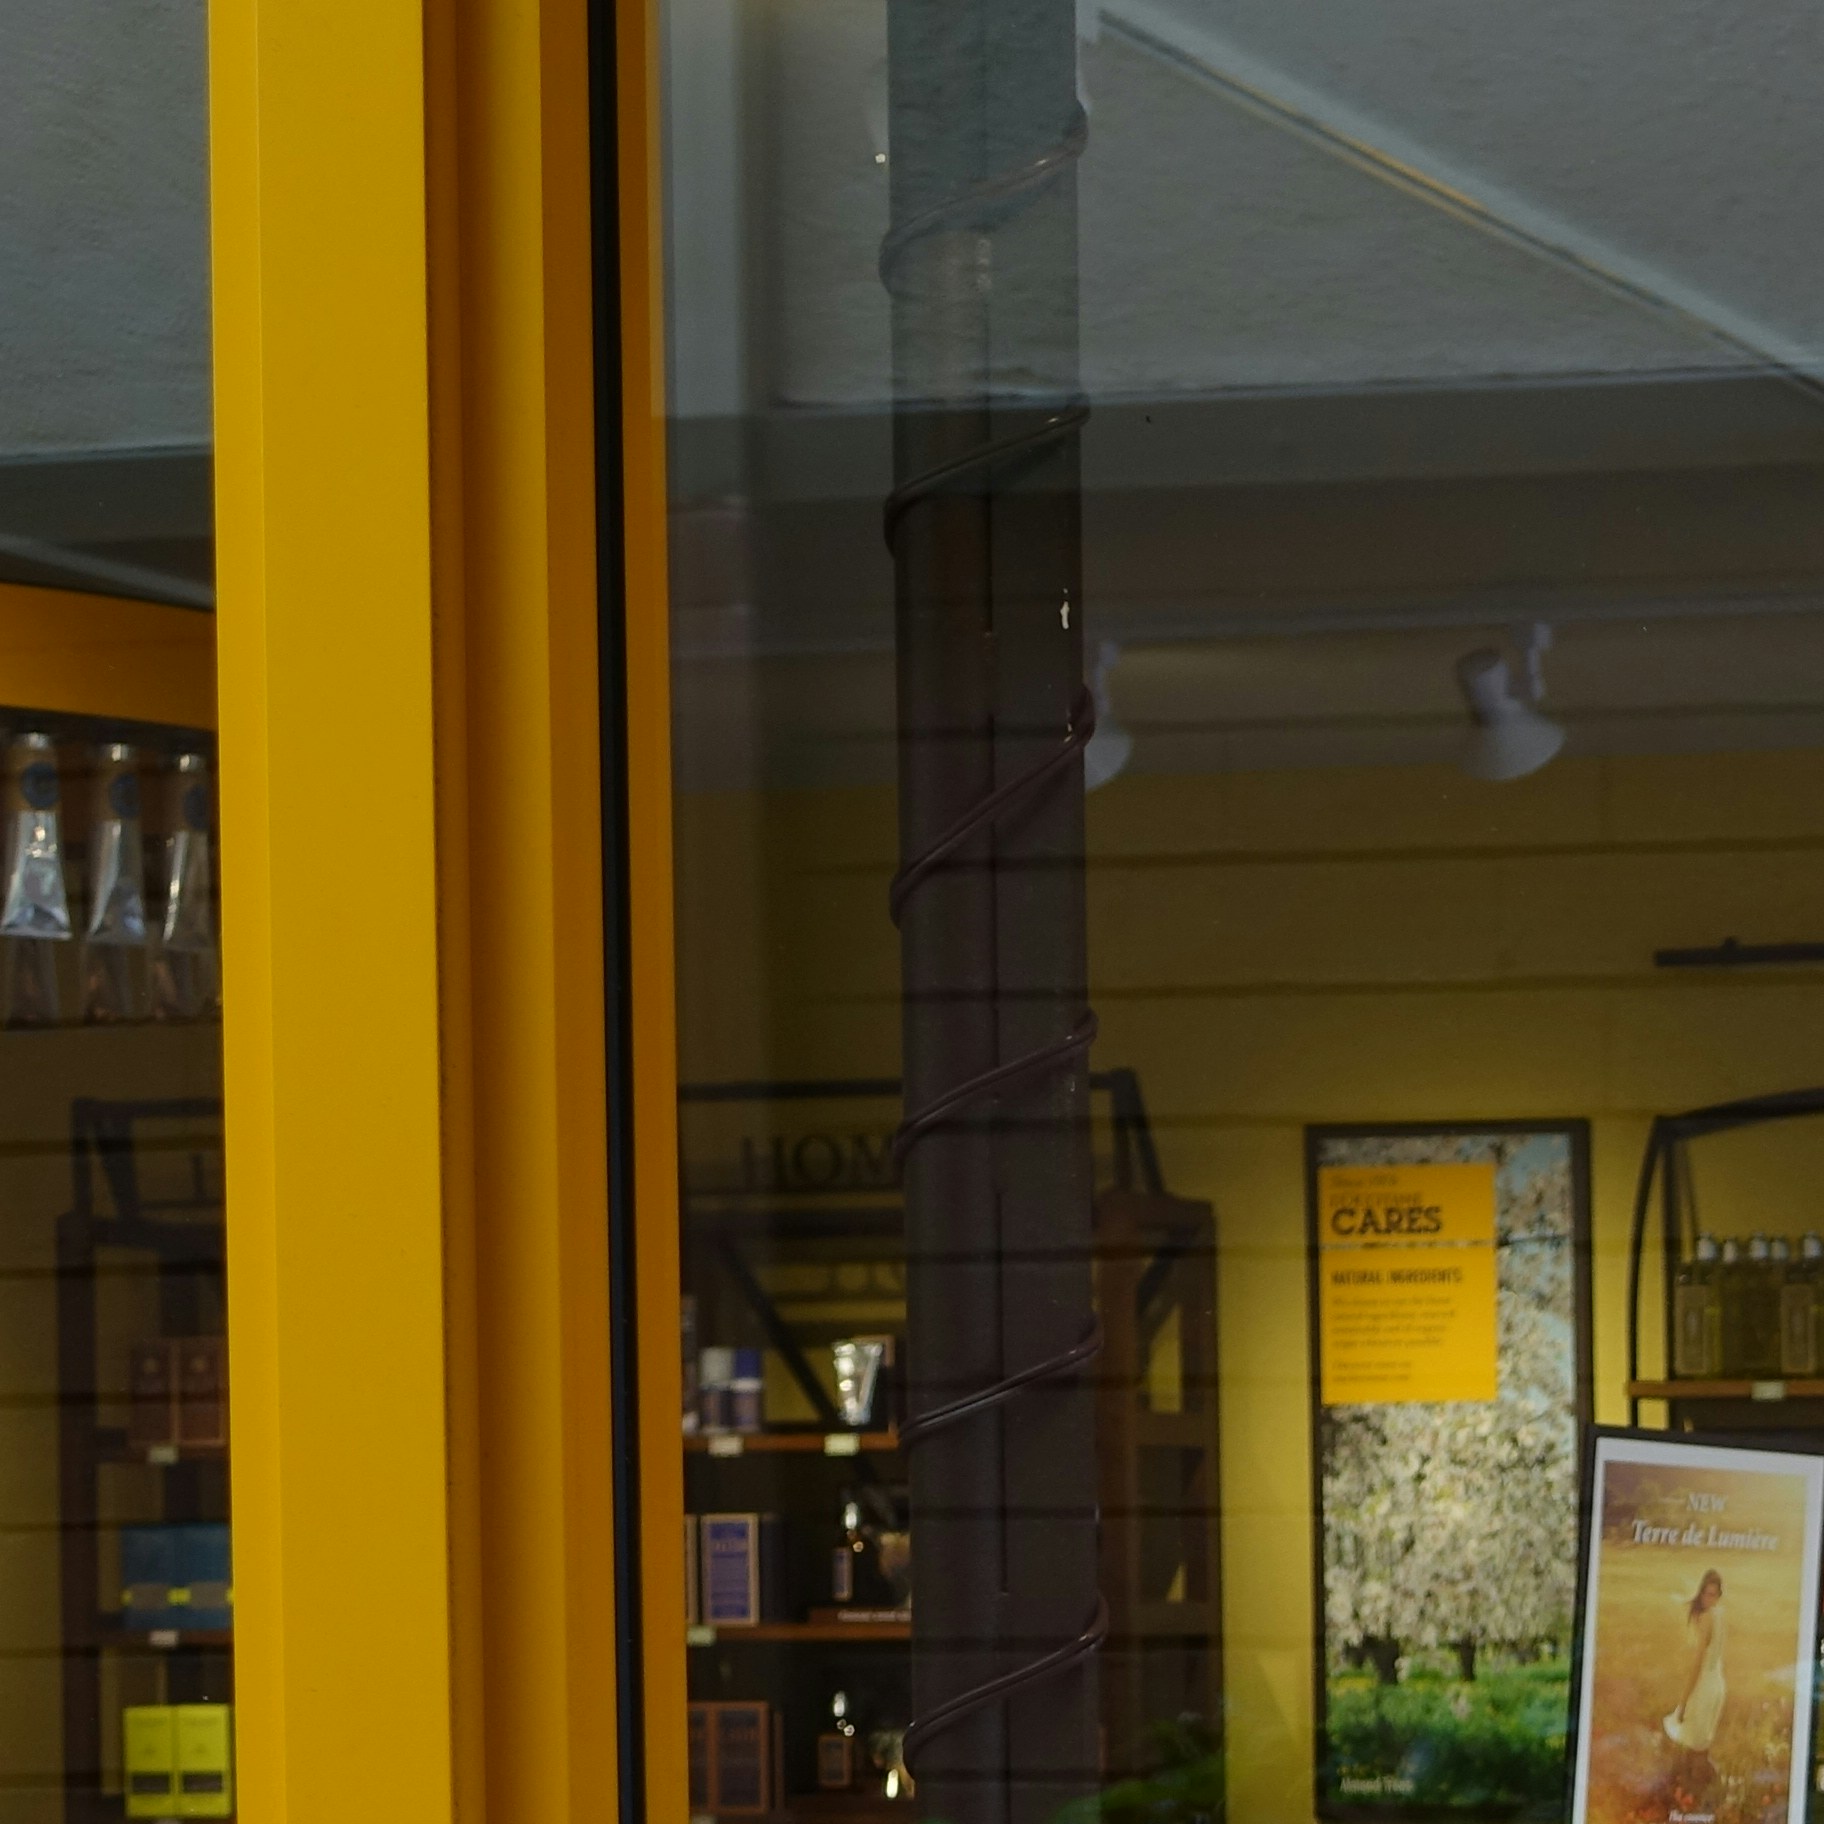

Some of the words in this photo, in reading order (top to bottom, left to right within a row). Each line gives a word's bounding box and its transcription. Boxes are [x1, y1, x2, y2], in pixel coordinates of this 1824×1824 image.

[1331, 1205, 1442, 1236] CARES
[1686, 1491, 1728, 1514] NEW
[1631, 1519, 1679, 1546] Terre
[1682, 1523, 1702, 1548] de
[1706, 1525, 1780, 1552] Lumière
